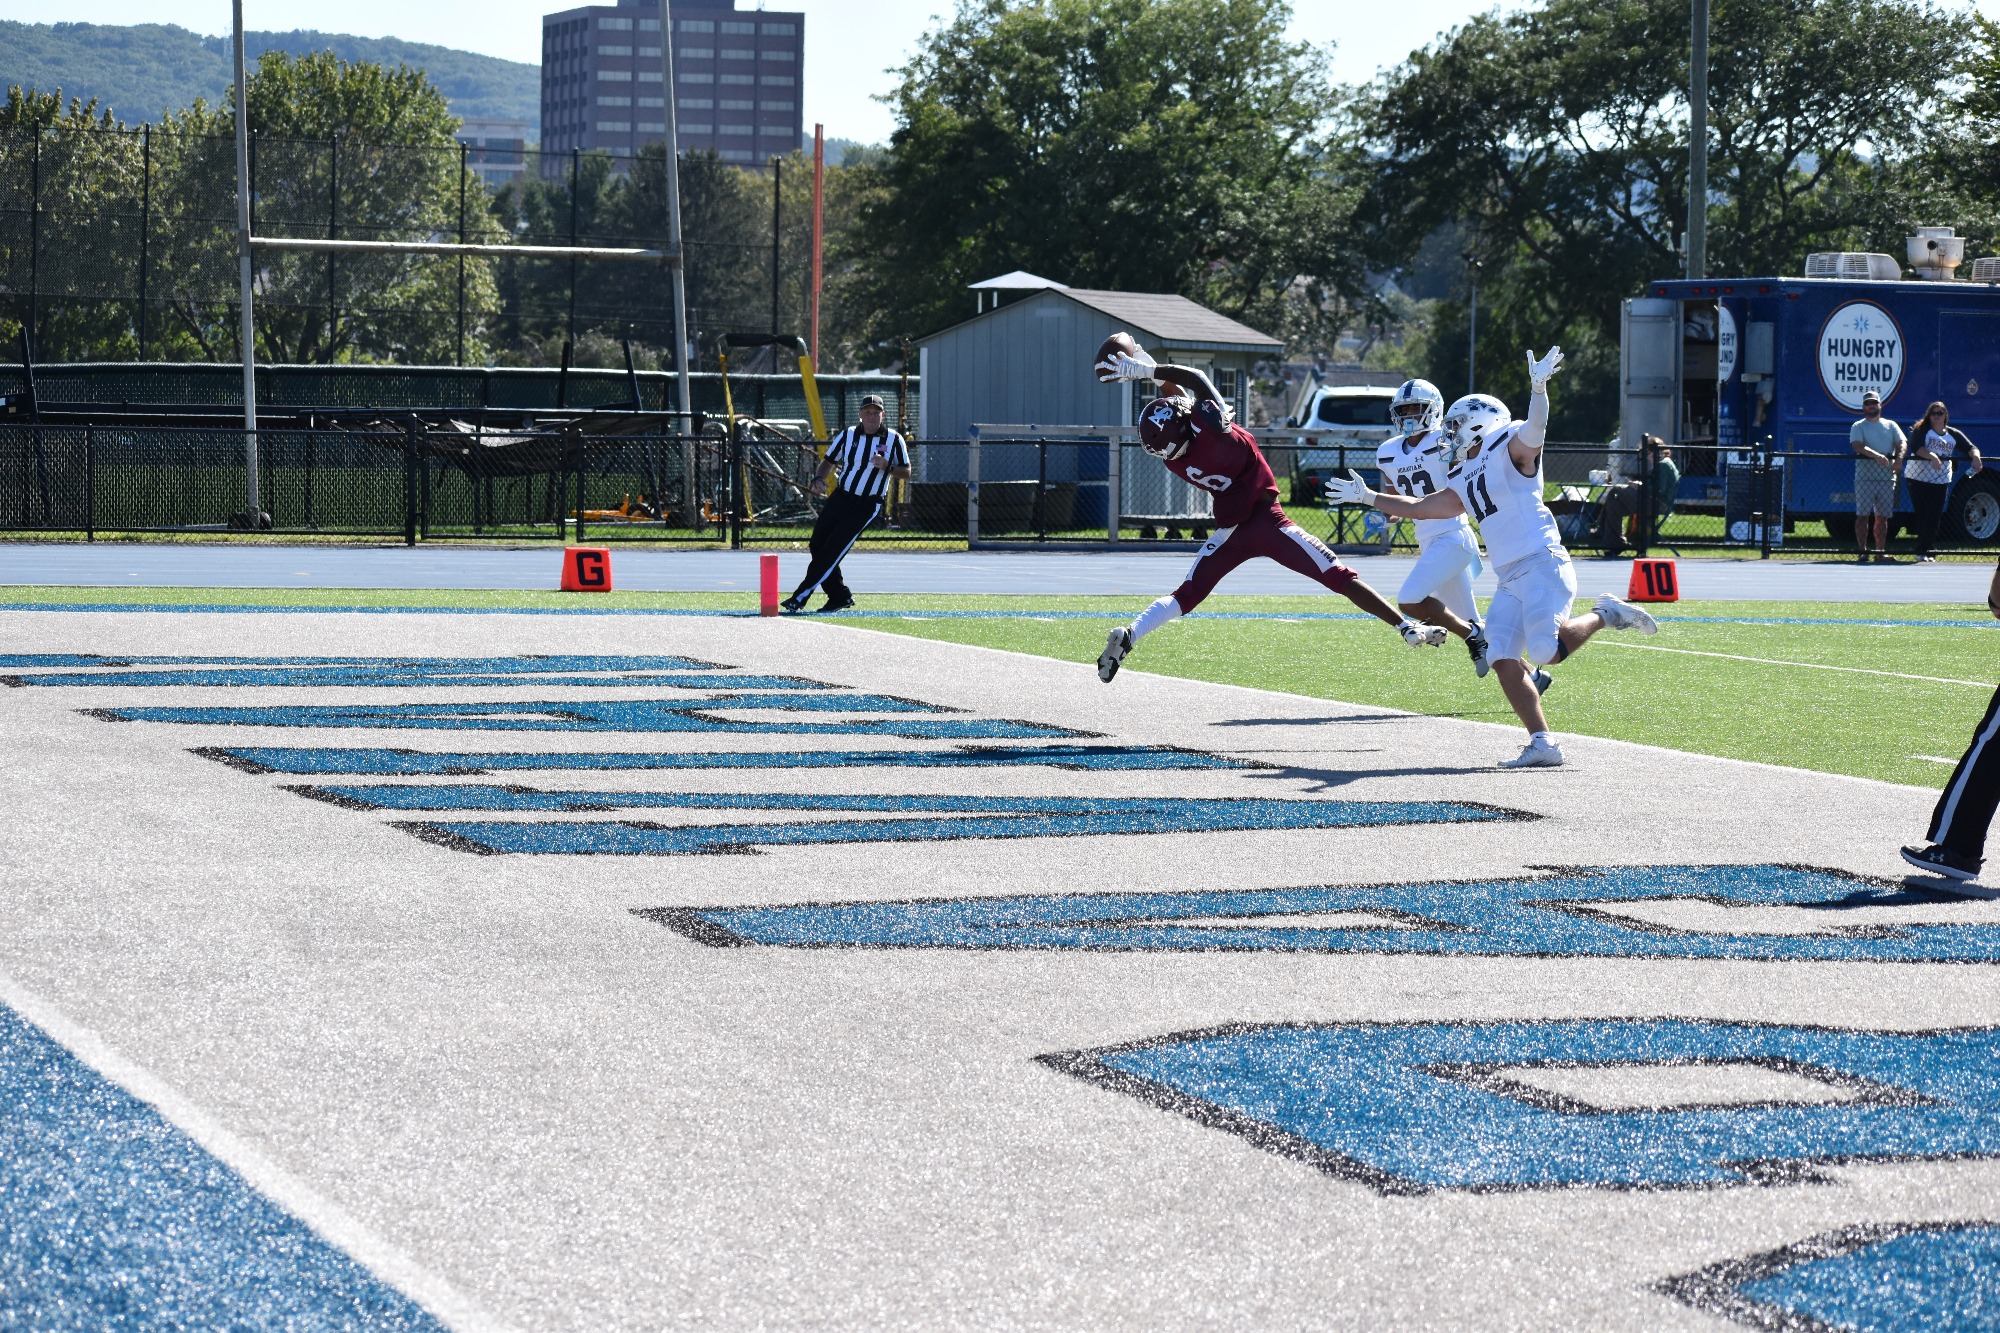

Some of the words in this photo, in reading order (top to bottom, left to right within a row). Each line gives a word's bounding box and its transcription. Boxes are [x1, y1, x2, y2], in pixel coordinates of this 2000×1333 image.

[1827, 338, 1896, 358] HUNGRY
[1835, 362, 1893, 382] HOUND
[1841, 385, 1881, 393] EXPRESS
[1148, 405, 1174, 432] AS
[1185, 465, 1233, 492] 6
[1467, 473, 1498, 523] 11
[576, 551, 605, 586] G
[1641, 562, 1674, 596] 10
